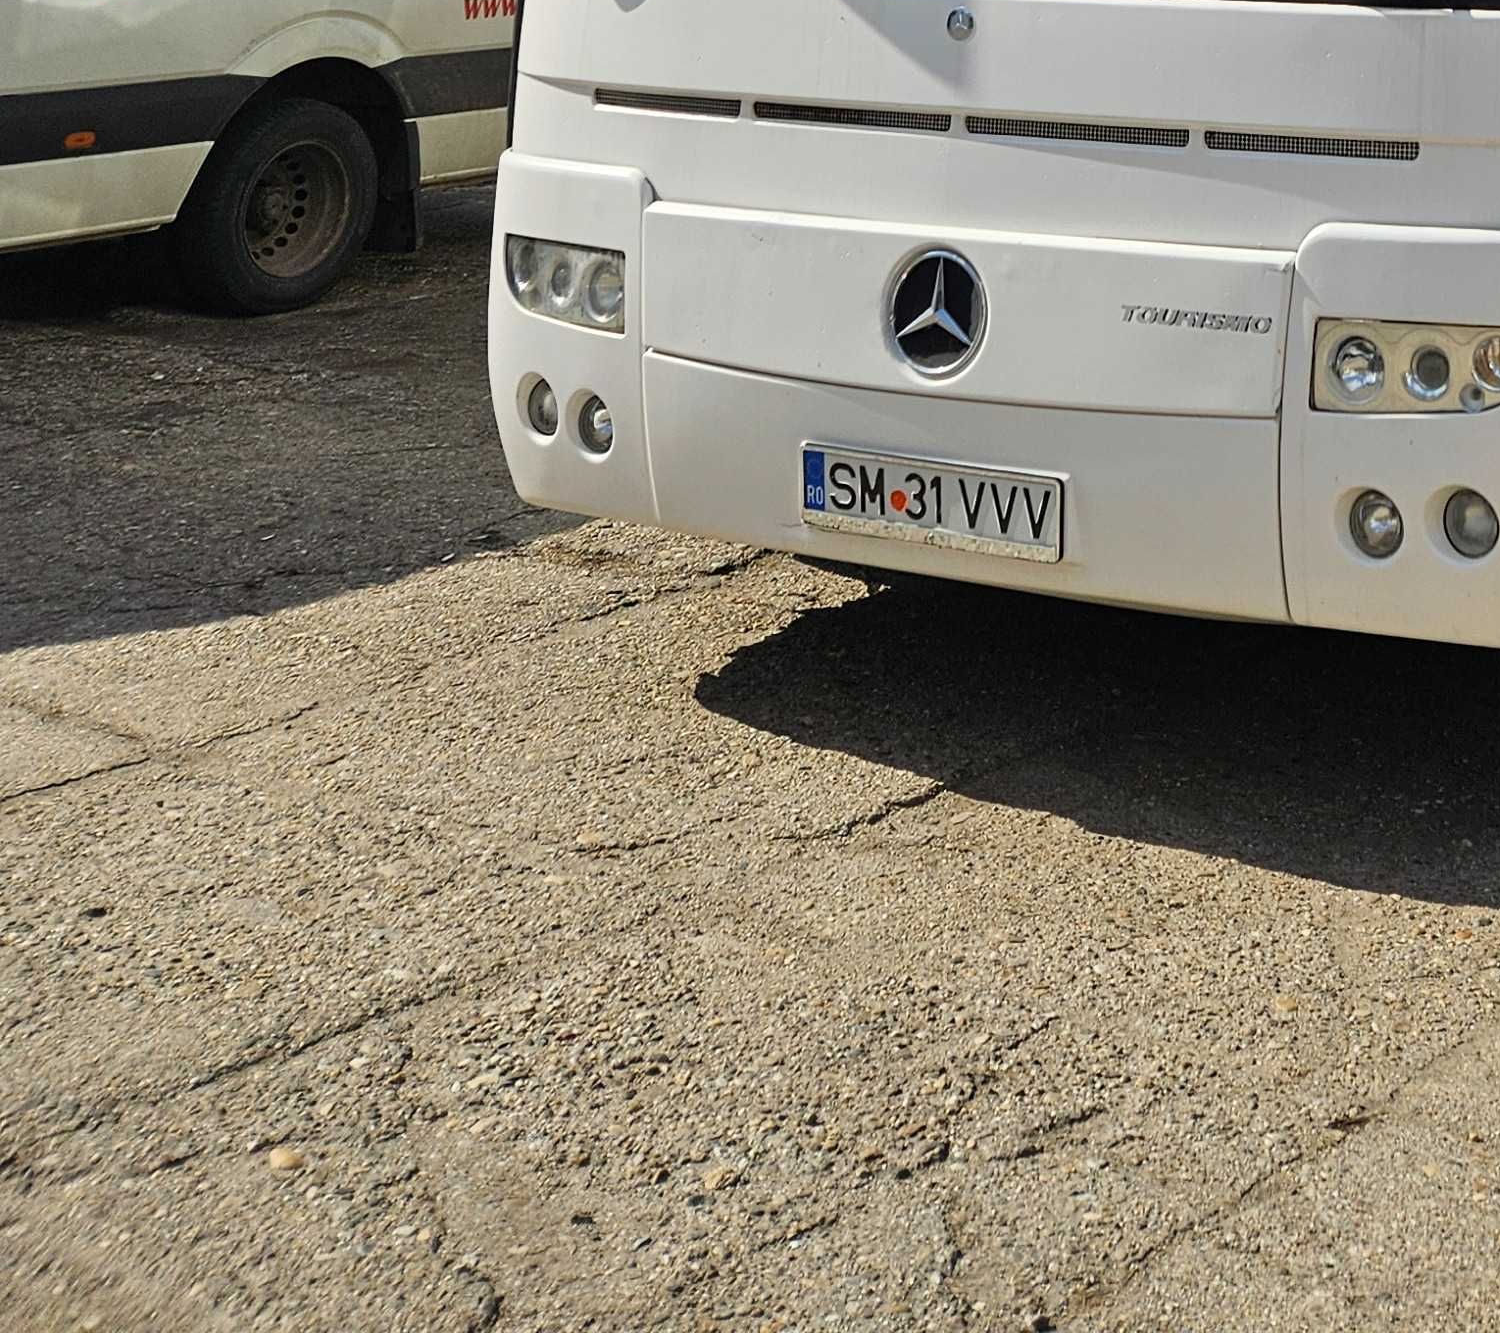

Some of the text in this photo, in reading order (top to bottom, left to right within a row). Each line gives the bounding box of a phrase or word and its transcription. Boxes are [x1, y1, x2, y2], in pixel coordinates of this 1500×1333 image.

[1120, 304, 1273, 334] TOURISMO
[807, 462, 1052, 540] RO SM 31 VVV
